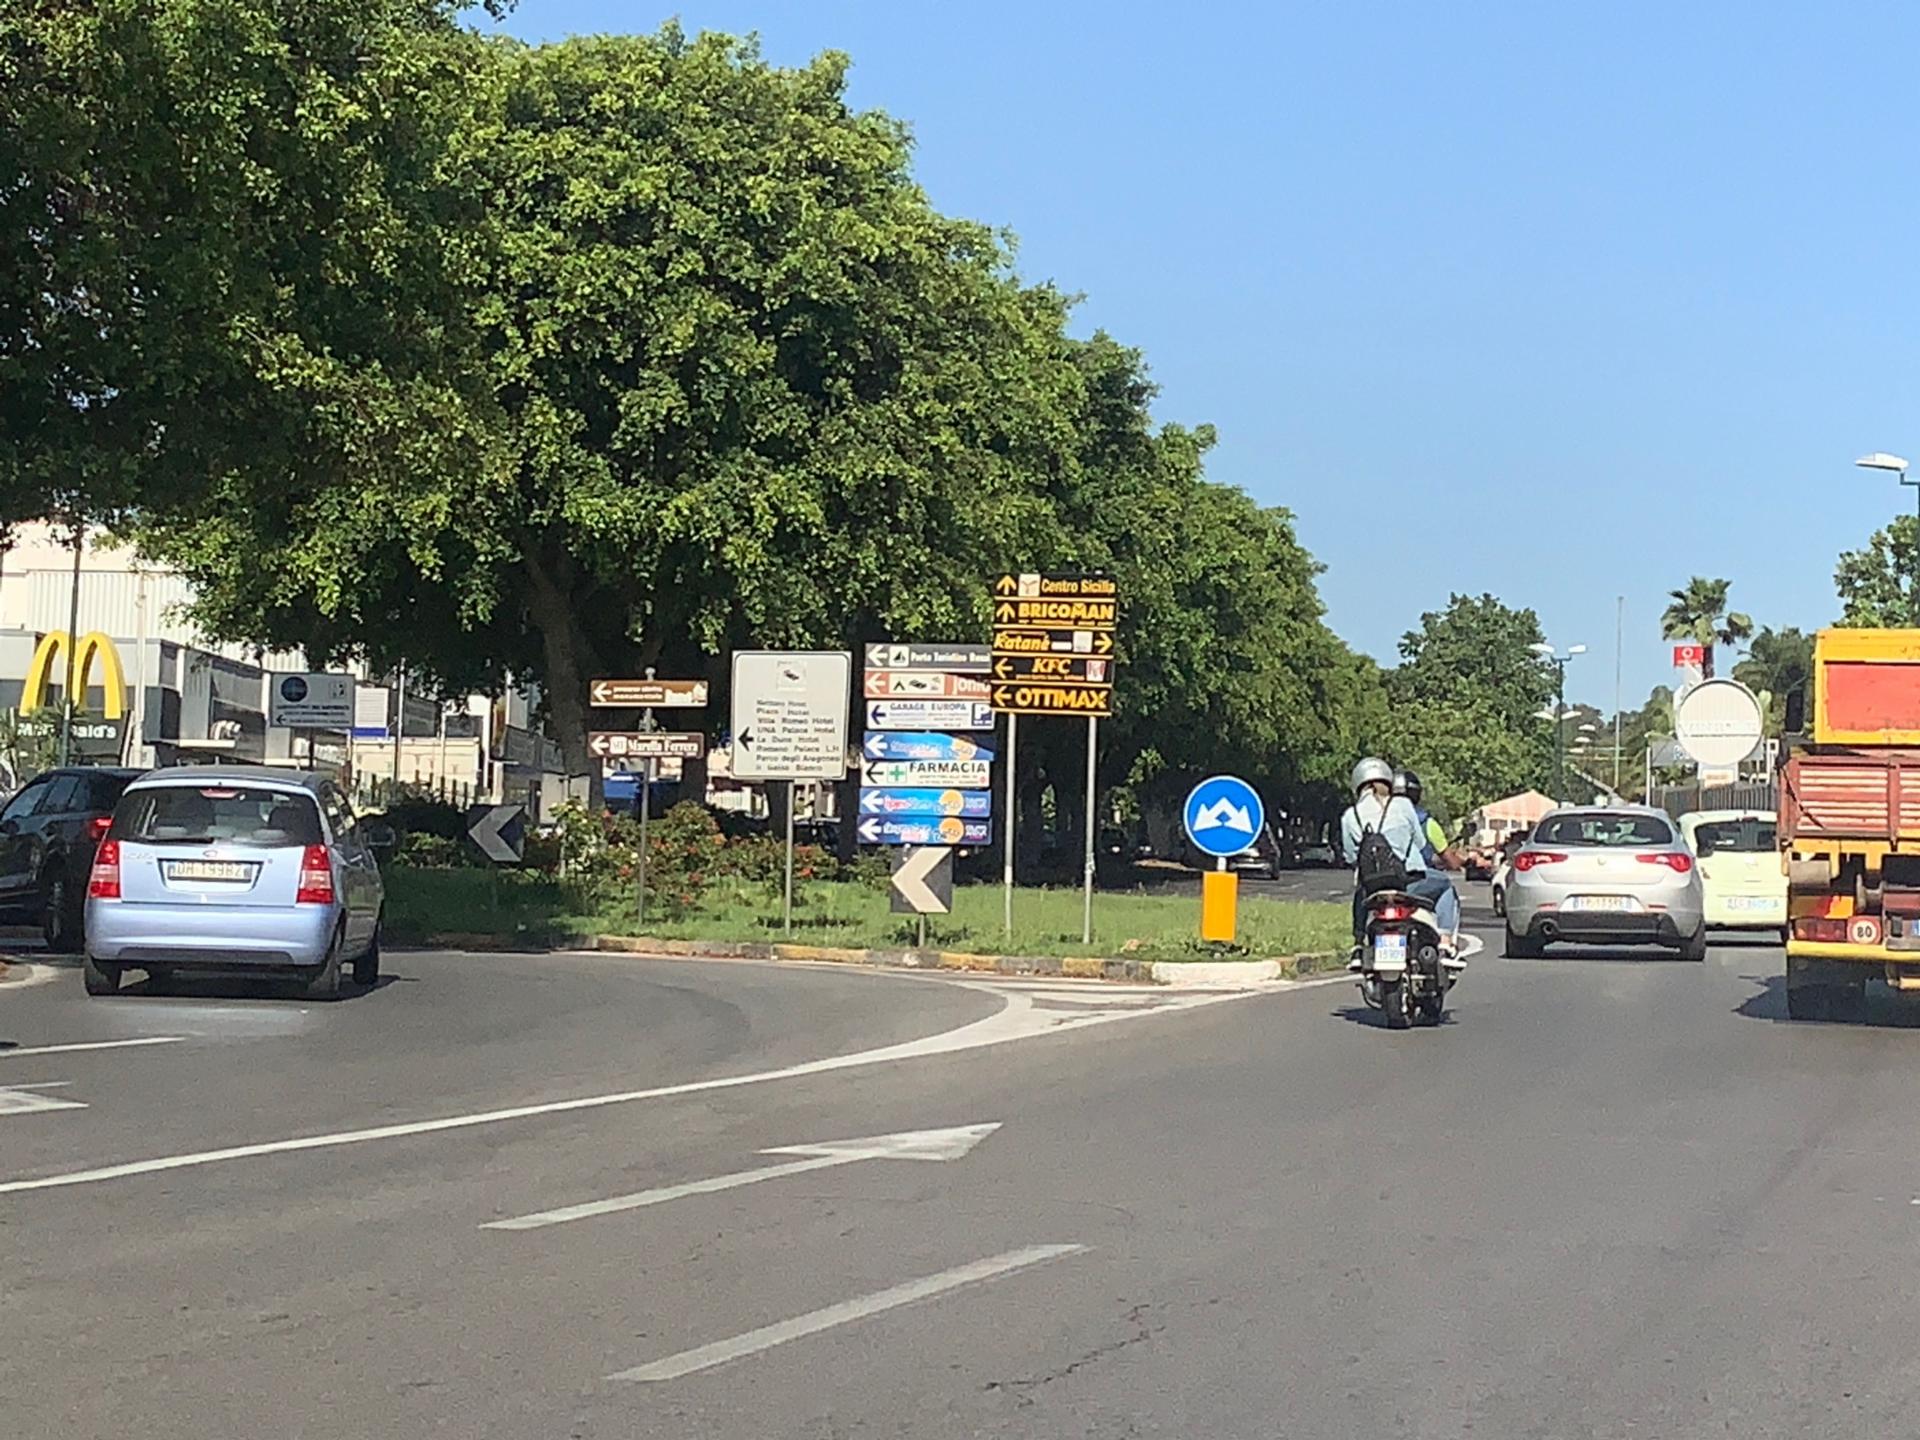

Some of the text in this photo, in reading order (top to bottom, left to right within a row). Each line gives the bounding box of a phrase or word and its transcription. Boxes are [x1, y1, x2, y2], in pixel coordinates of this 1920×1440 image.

[1041, 579, 1116, 594] Centro Sicilia
[1018, 603, 1115, 620] BRICOMAN
[911, 651, 932, 662] Porto
[1032, 658, 1071, 674] KFC
[1015, 687, 1108, 709] OTTIMAX
[931, 702, 967, 711] EUROPA
[814, 727, 836, 735] Hotel
[909, 762, 986, 774] FARMACIA
[1857, 926, 1872, 938] 80
